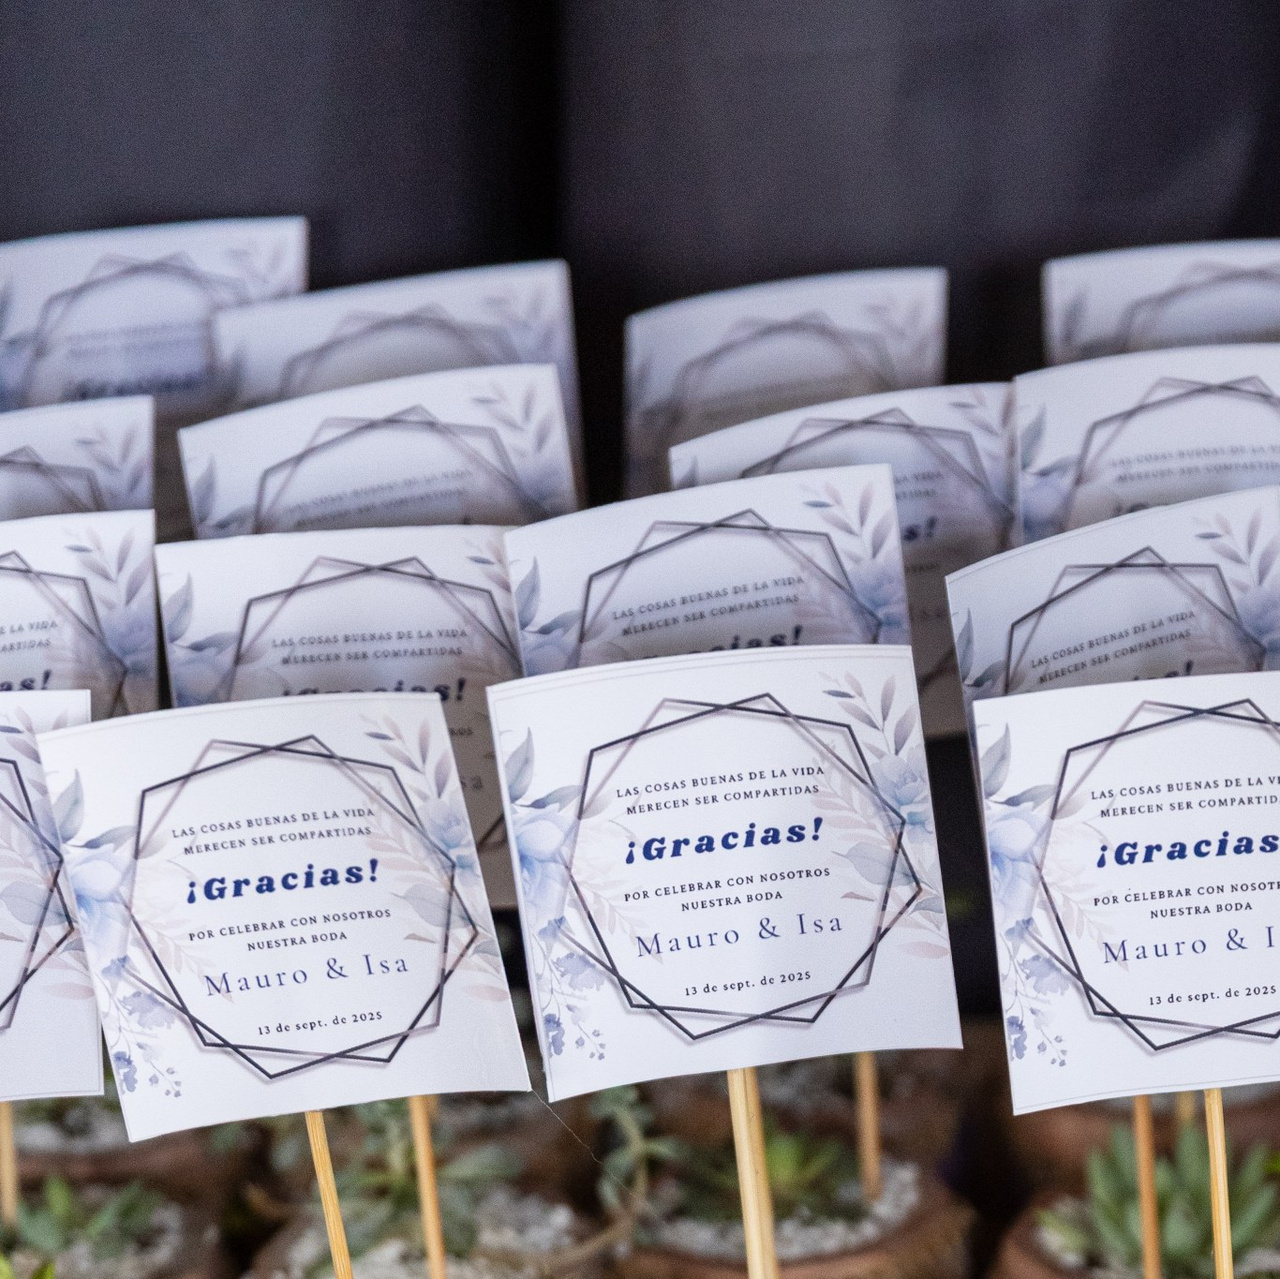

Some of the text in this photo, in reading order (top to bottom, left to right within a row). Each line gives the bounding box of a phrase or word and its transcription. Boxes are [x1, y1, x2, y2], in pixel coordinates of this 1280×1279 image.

[612, 576, 804, 620] LAS COSAS BUENAS DE LA VIDA
[1031, 610, 1196, 669] LAS COSAS BUENAS DE LA VIDA
[615, 765, 825, 798] LAS COSAS BUENAS DE LA VIDA
[1090, 788, 1114, 800] LAS
[1118, 783, 1162, 797] COSAS
[1166, 779, 1220, 793] BUENAS
[1224, 777, 1242, 788] DE
[1247, 776, 1263, 787] LA
[625, 784, 819, 815] MERECEN SER COMPARTIDAS
[1099, 803, 1163, 818] MERECEN
[1168, 800, 1194, 811] SER
[171, 807, 375, 839] LAS COSAS BUENAS DE LA VIDA
[183, 825, 372, 855] MERECEN SER COMPARTIDAS
[624, 816, 823, 865] ¡Gracias!
[186, 857, 378, 904] ¡Gracias!
[623, 867, 830, 902] POR CELEBRAR CON NOSOTROS
[1092, 894, 1119, 907] POR
[1123, 889, 1192, 903] CELEBRAR
[1196, 884, 1224, 896] CON
[680, 890, 783, 912] NUESTRA BODA
[1149, 901, 1253, 919] NUESTRA BODA
[187, 908, 391, 942] POR CELEBRAR CON NOSOTROS
[634, 912, 842, 957] Mauro & Isa
[246, 930, 347, 952] NUESTRA BODA
[1101, 939, 1207, 964] Mauro
[1225, 927, 1248, 951] &
[203, 953, 408, 996] Mauro & Isa
[684, 970, 811, 996] 13 de sept. de 2025
[1149, 984, 1277, 1006] 13 de sept. de 2025
[257, 1010, 382, 1036] 13 de sept. de 2025
